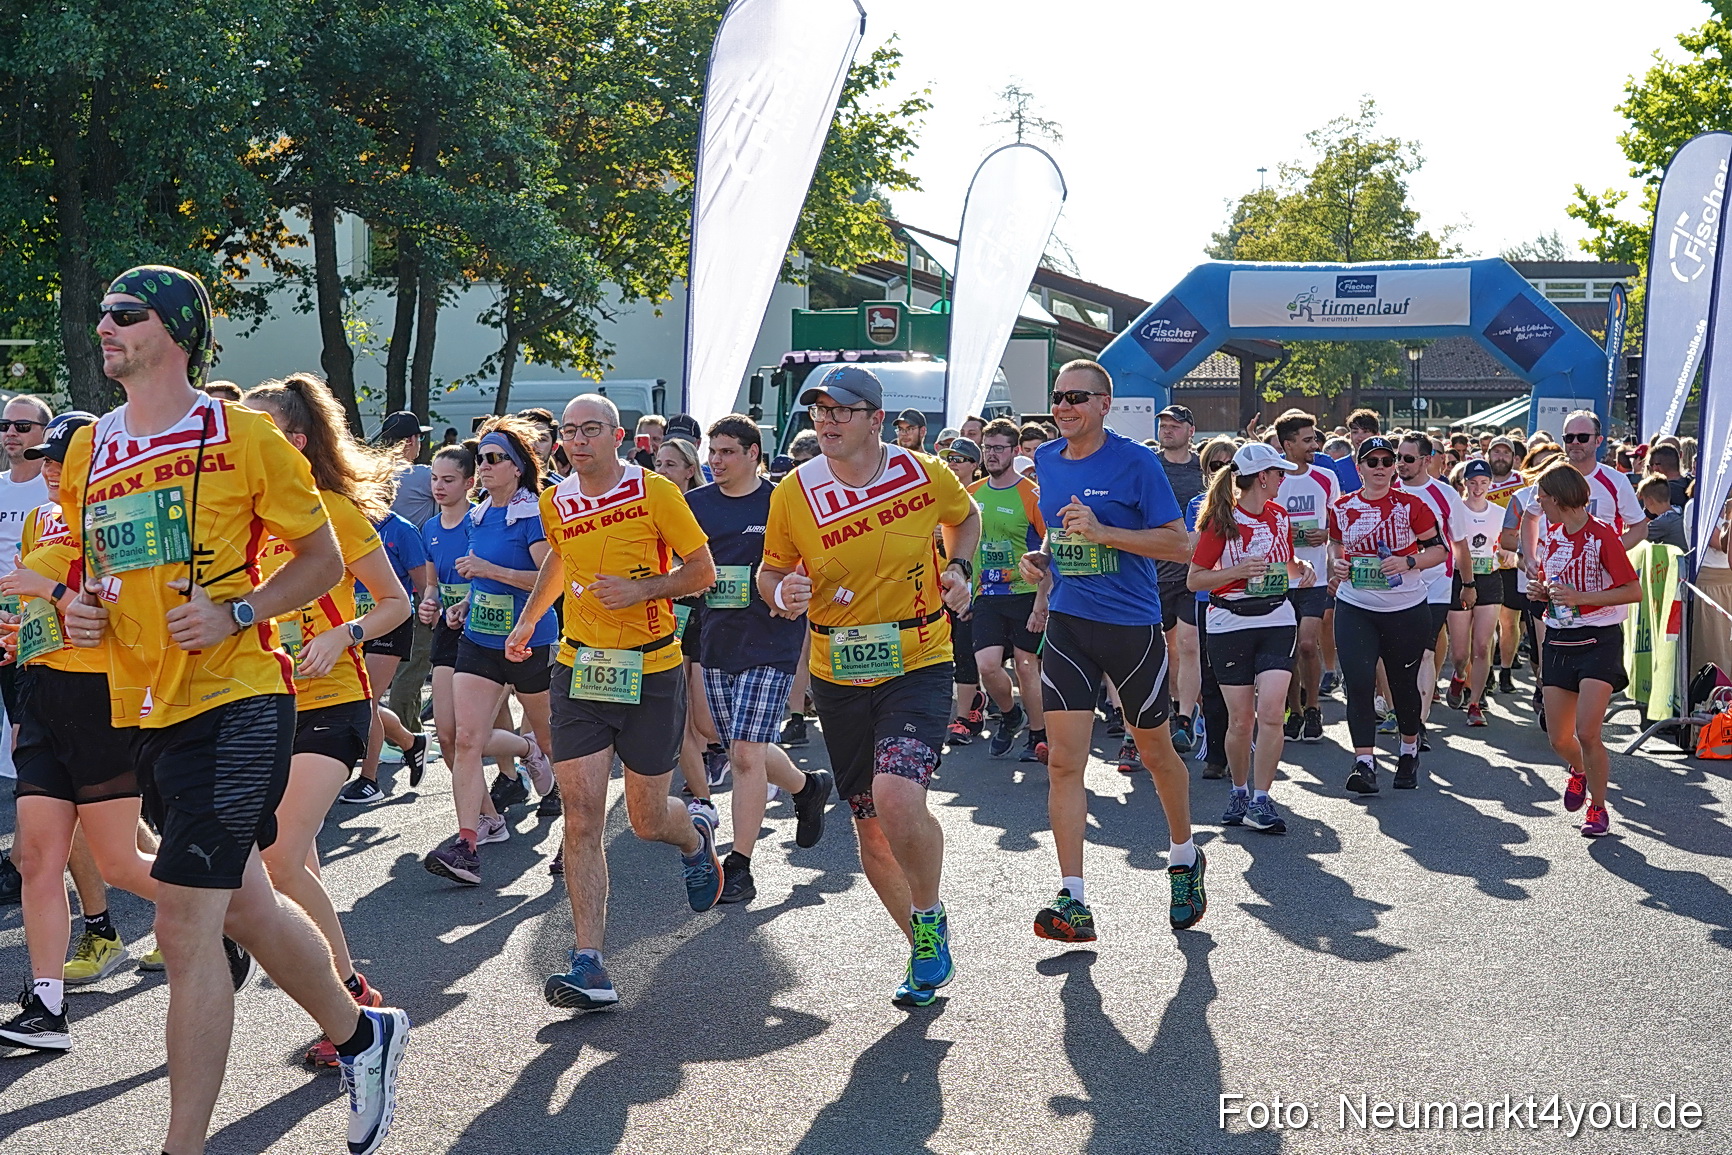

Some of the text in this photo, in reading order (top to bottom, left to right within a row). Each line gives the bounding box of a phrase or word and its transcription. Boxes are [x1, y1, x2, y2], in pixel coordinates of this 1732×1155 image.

[1684, 158, 1728, 263] Fischer
[1343, 281, 1375, 291] Fischer
[1321, 298, 1411, 316] firmenlauf
[1321, 315, 1359, 323] neumarkt
[1150, 325, 1198, 338] Fischer
[1513, 325, 1526, 333] das
[87, 453, 235, 505] MAX BÖGL
[563, 505, 648, 540] MAX BÖGL
[821, 492, 935, 550] MAX BÖGL
[95, 521, 136, 552] 808
[145, 521, 158, 556] 2022
[120, 546, 146, 557] Daniel
[987, 551, 1004, 561] 599
[1057, 544, 1083, 560] 449
[475, 605, 504, 622] 1368
[22, 619, 43, 644] 803
[47, 616, 59, 642] 2022
[834, 652, 842, 670] RUN
[842, 642, 890, 662] 1625
[891, 643, 900, 669] 2022
[584, 665, 628, 685] 1631
[842, 662, 870, 670] Neumeier
[575, 670, 583, 689] RUN
[631, 672, 639, 696] 2022
[603, 685, 631, 694] Andreas
